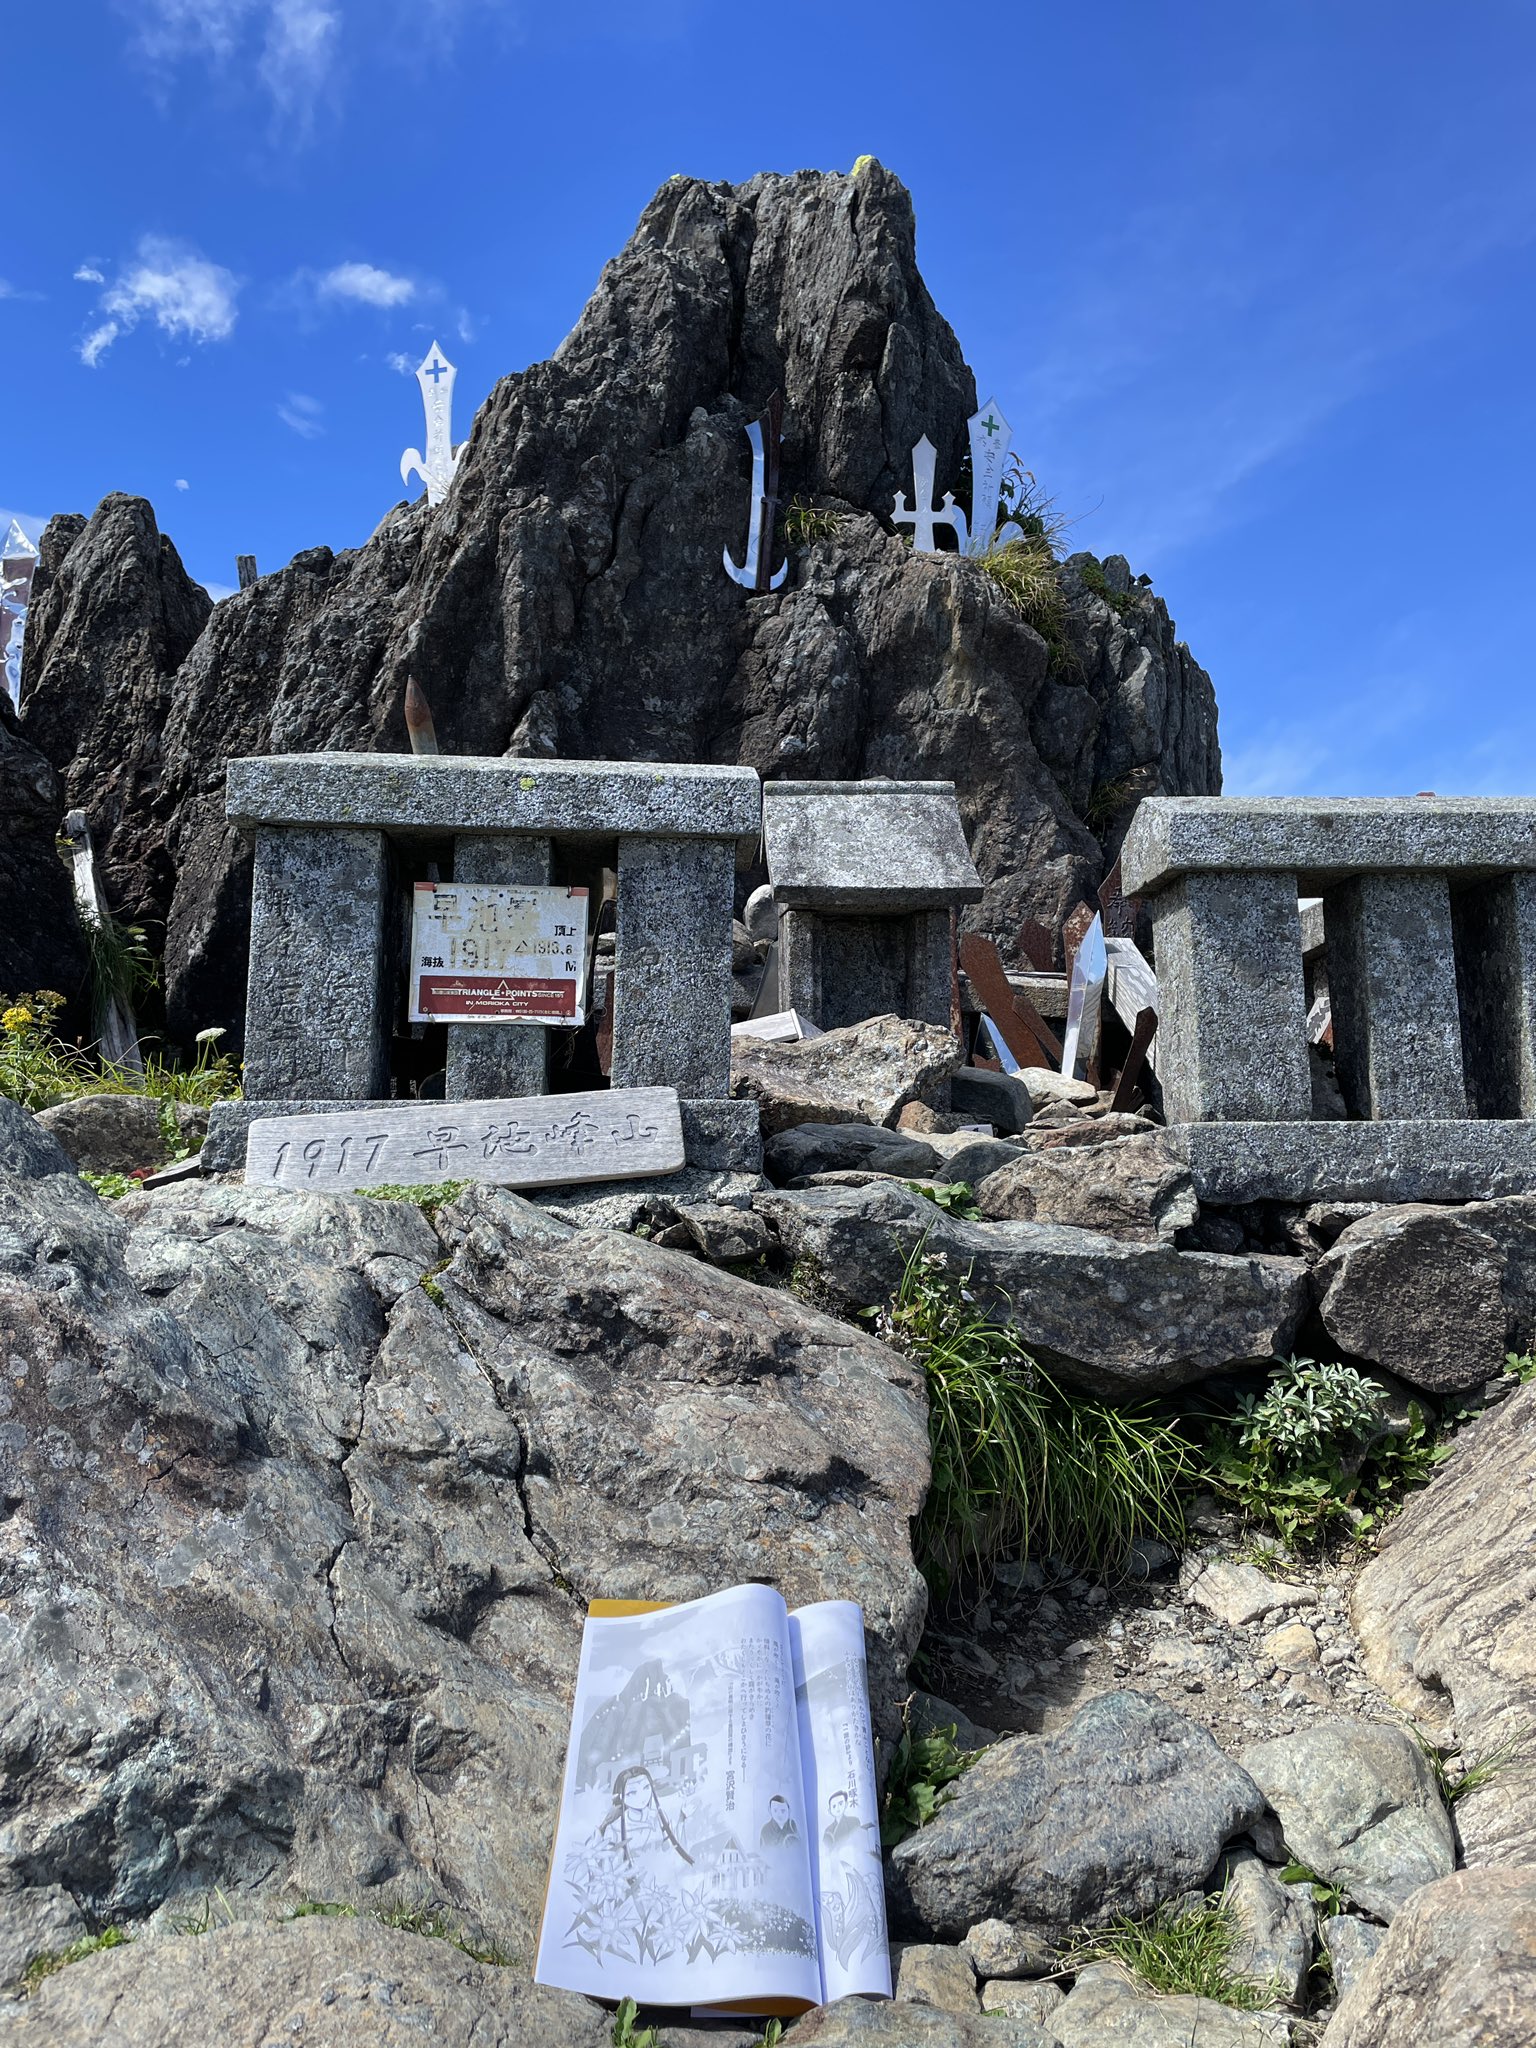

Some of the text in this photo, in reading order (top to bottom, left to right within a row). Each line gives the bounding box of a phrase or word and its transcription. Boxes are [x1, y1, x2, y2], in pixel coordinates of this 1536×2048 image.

[554, 925, 577, 936] 頂上
[421, 956, 444, 968] 海抜
[457, 989, 500, 997] TRIANGLE
[505, 990, 538, 998] POINTS
[272, 1134, 389, 1179] 1917
[726, 1770, 736, 1812] 宮沢賢治
[847, 1769, 858, 1808] 石川啄木
